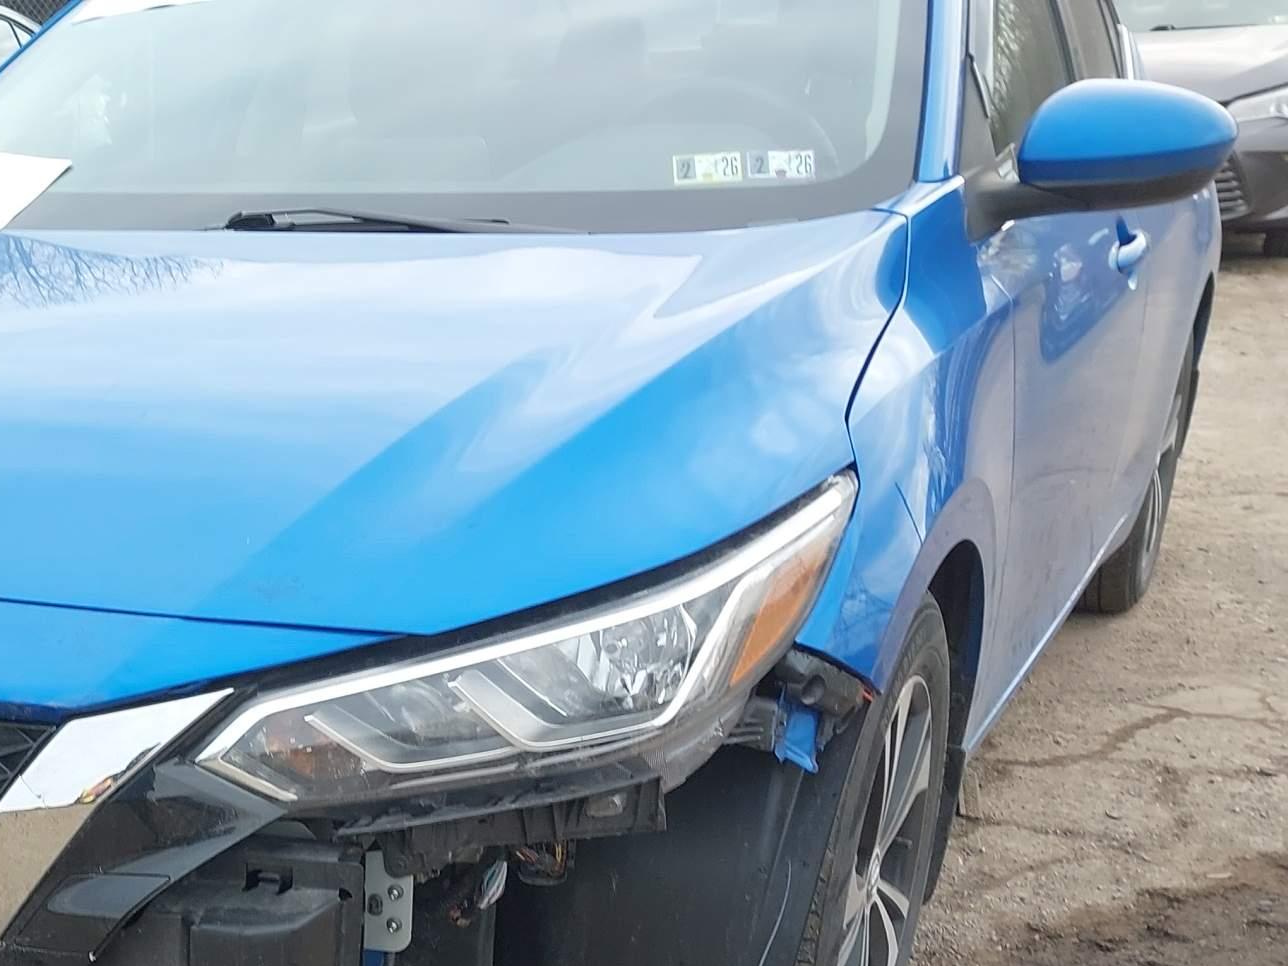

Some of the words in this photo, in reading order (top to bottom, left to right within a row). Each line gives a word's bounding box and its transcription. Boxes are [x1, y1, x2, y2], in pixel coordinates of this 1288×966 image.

[679, 160, 692, 179] 2
[721, 155, 739, 177] 26
[754, 155, 767, 175] 2
[795, 153, 813, 175] 26
